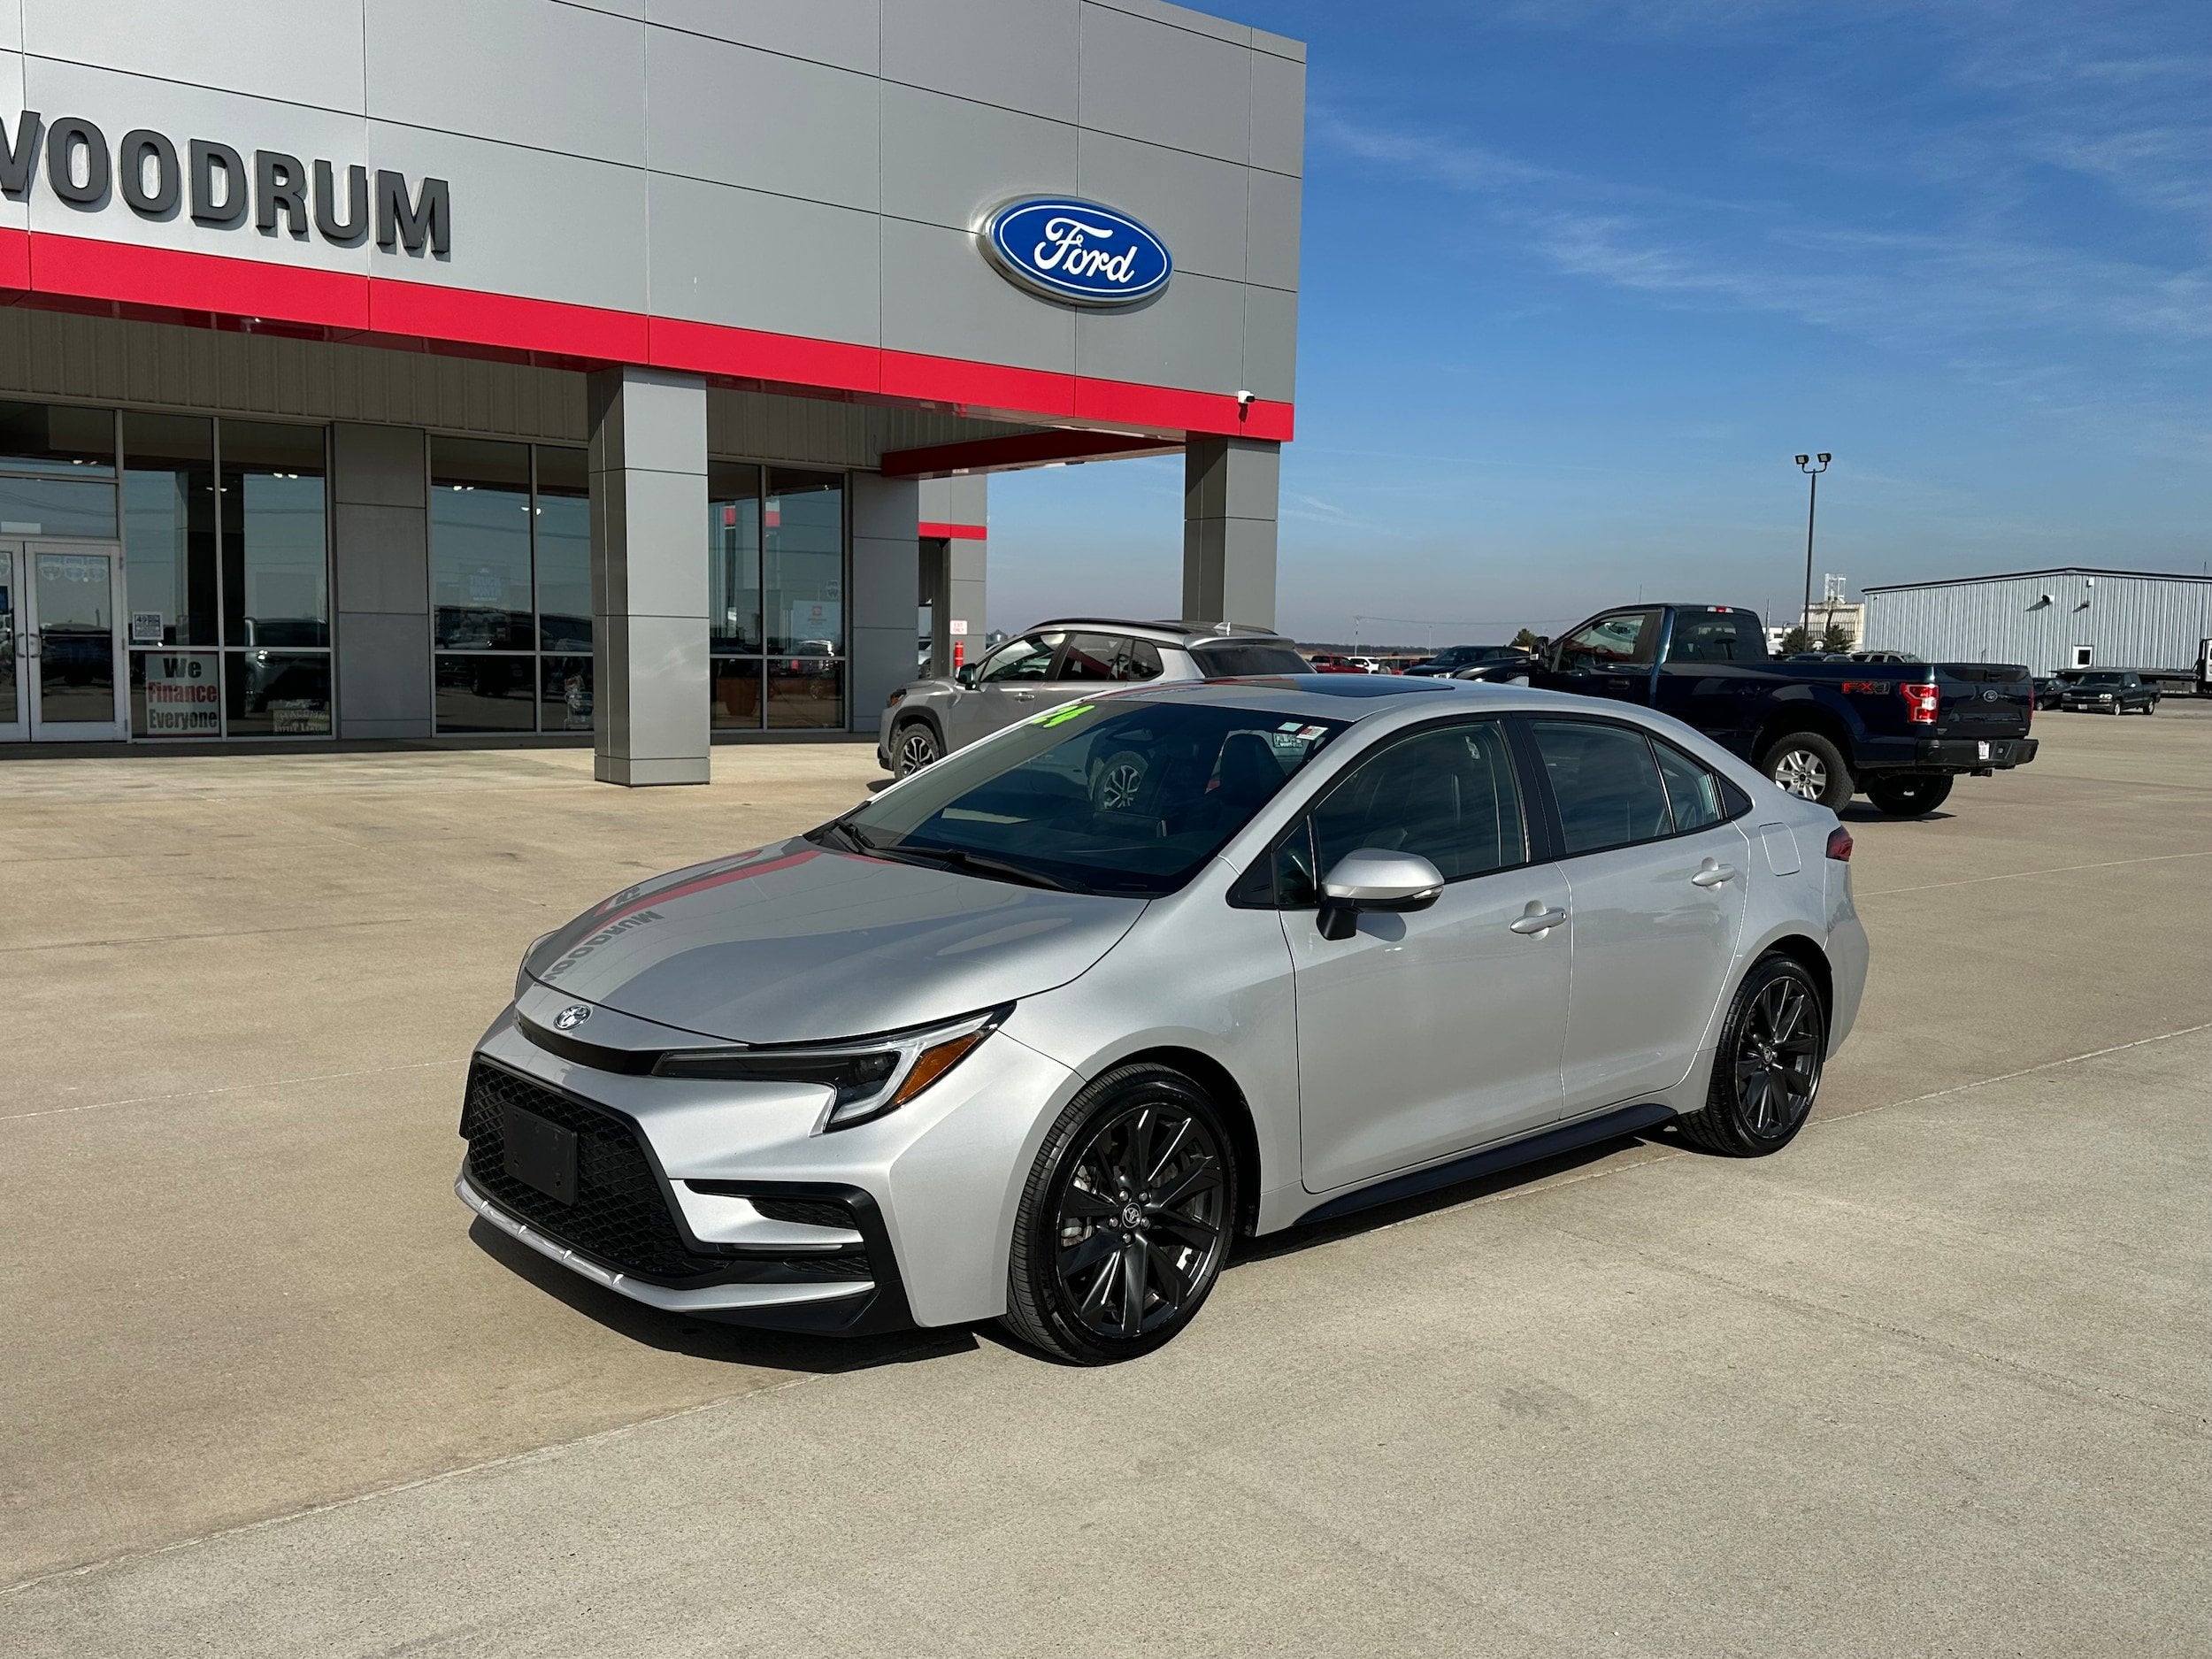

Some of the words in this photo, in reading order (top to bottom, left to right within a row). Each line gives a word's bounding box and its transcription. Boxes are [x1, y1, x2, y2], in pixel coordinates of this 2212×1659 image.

[1033, 218, 1138, 283] Ford
[163, 657, 202, 678] We
[148, 681, 218, 703] Finance
[1841, 680, 1891, 695] FX4
[149, 709, 218, 730] Everyone
